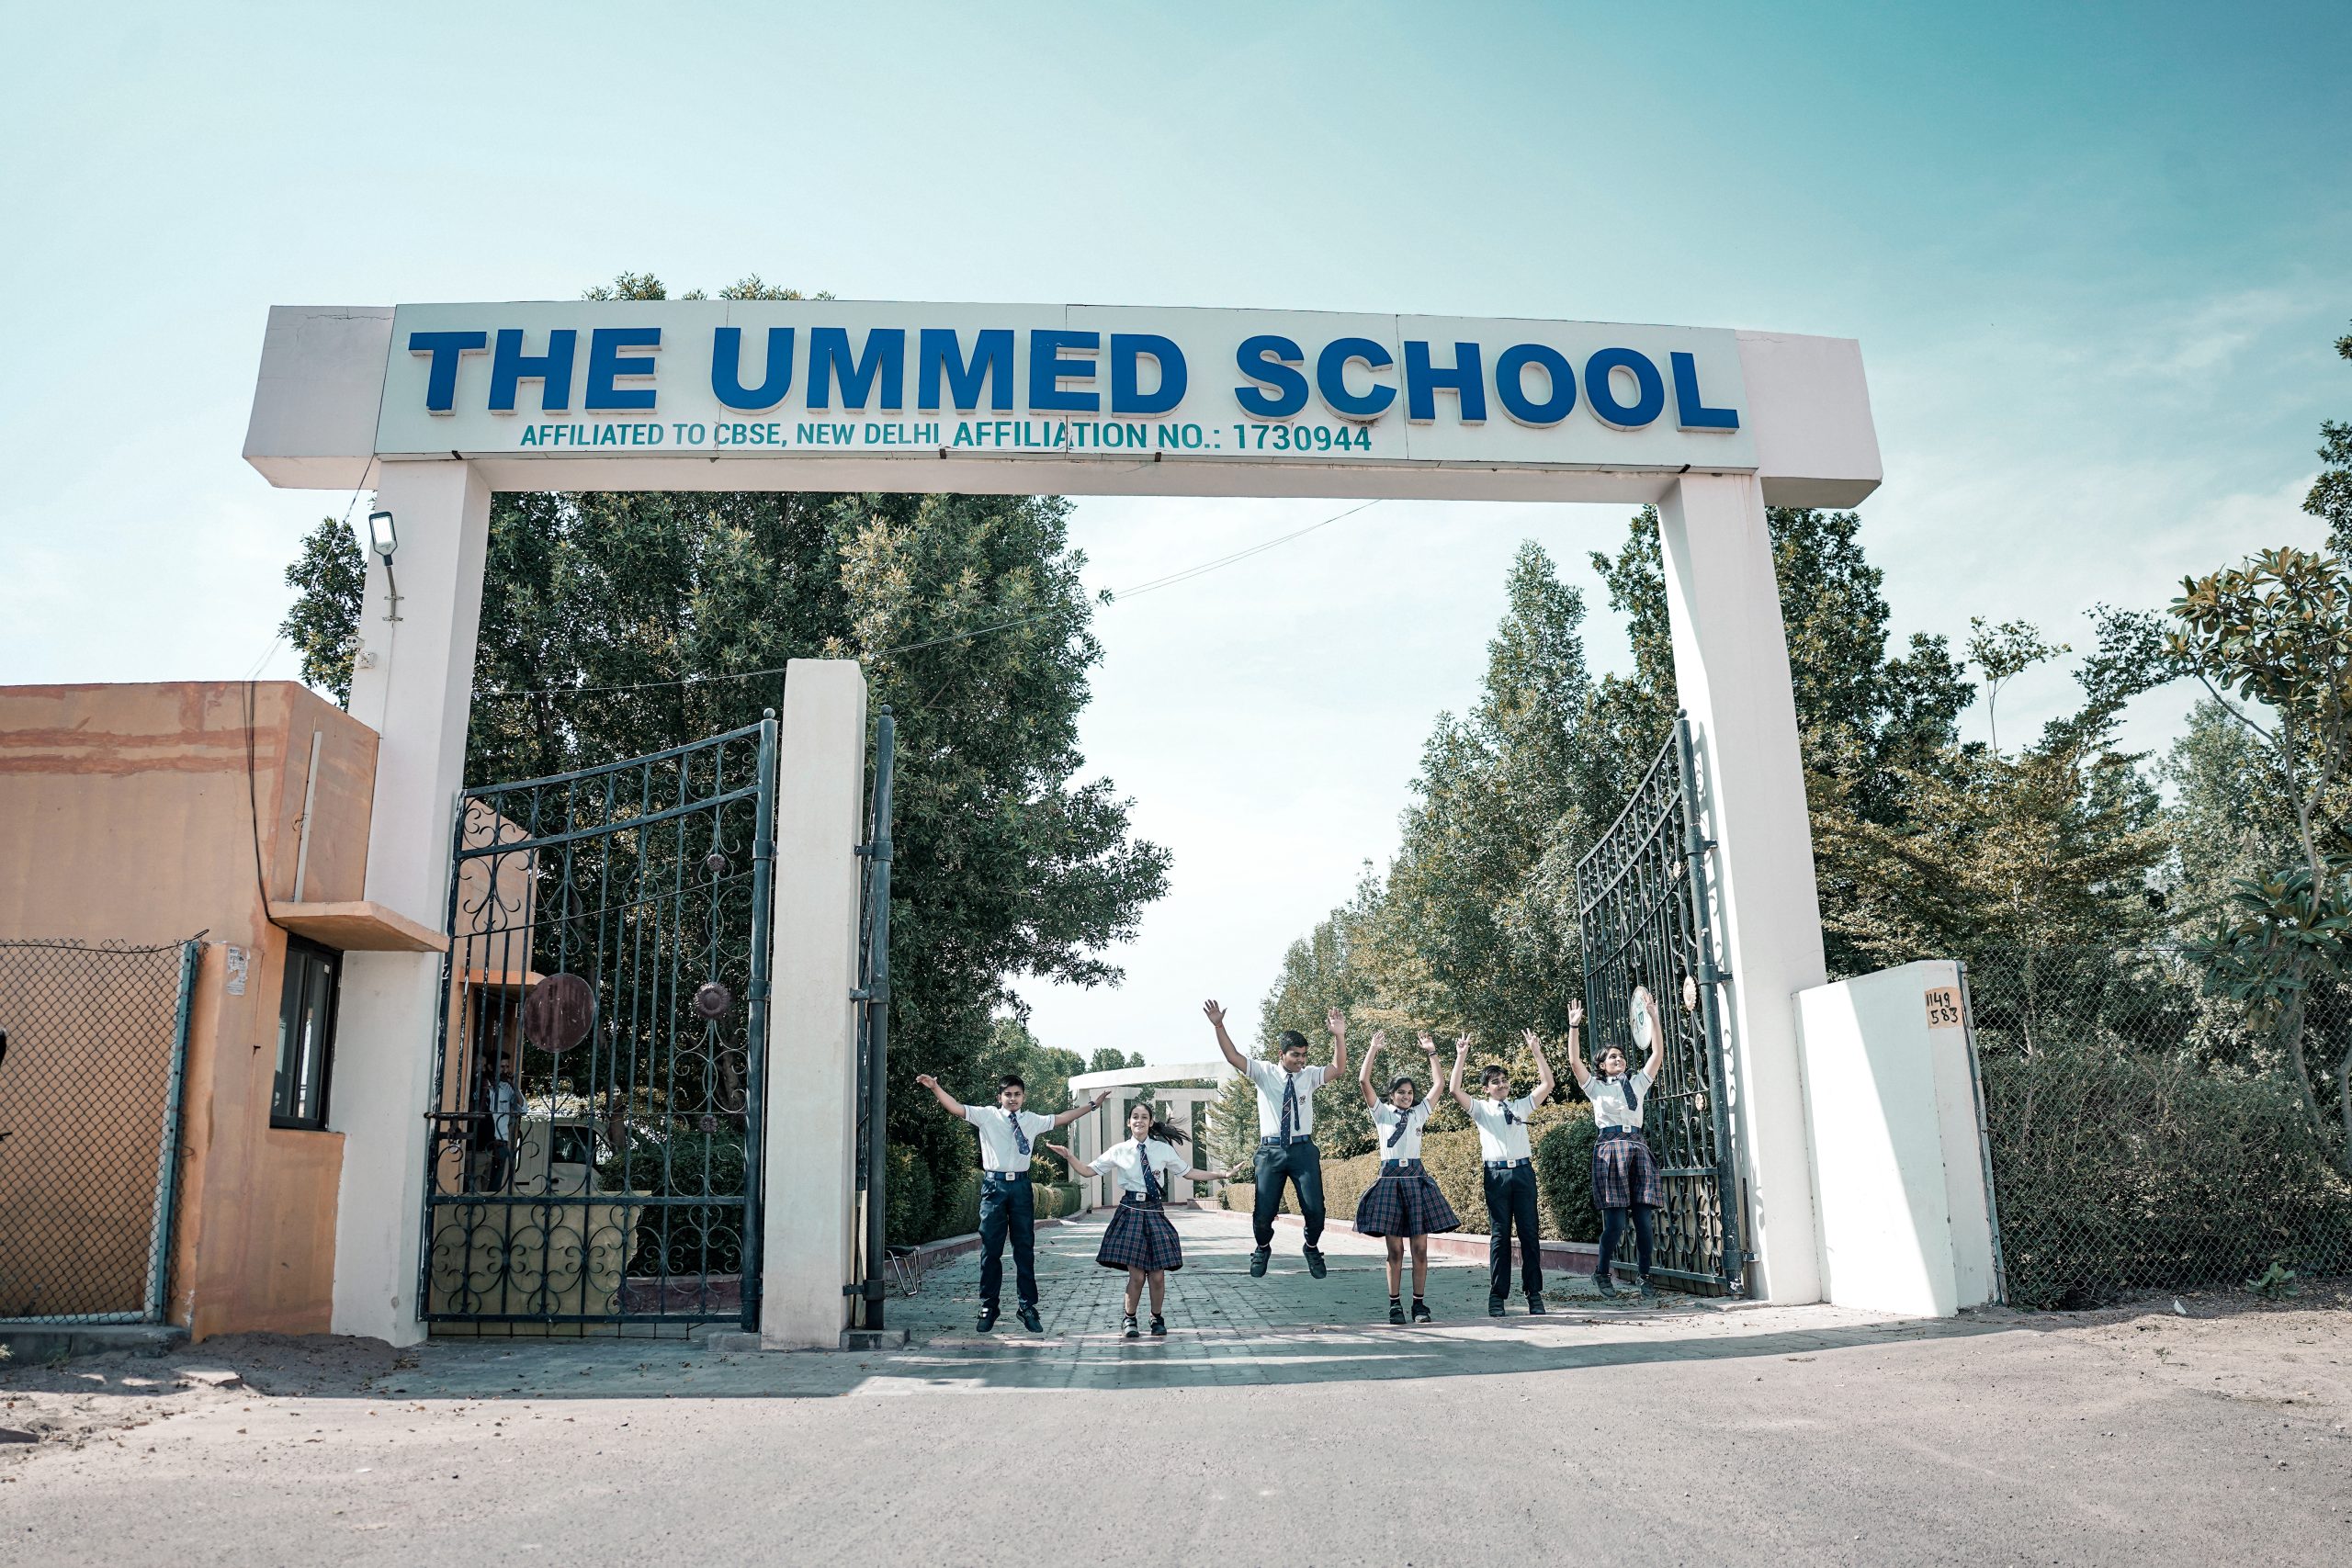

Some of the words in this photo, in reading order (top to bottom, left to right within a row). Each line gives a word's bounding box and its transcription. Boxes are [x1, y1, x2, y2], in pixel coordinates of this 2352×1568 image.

[409, 328, 662, 415] THE
[712, 328, 1188, 419] UMMED
[1234, 334, 1739, 434] SCHOOL
[520, 423, 664, 446] AFFILIATED
[673, 423, 706, 445] TO
[713, 423, 787, 447] CBSE,
[797, 423, 855, 445] NEW
[865, 423, 940, 445] DELHI
[953, 422, 1148, 449] AFFILIATION
[1158, 423, 1221, 449] NO.:
[1234, 423, 1373, 452] 1730944
[1930, 1007, 1959, 1024] 583
